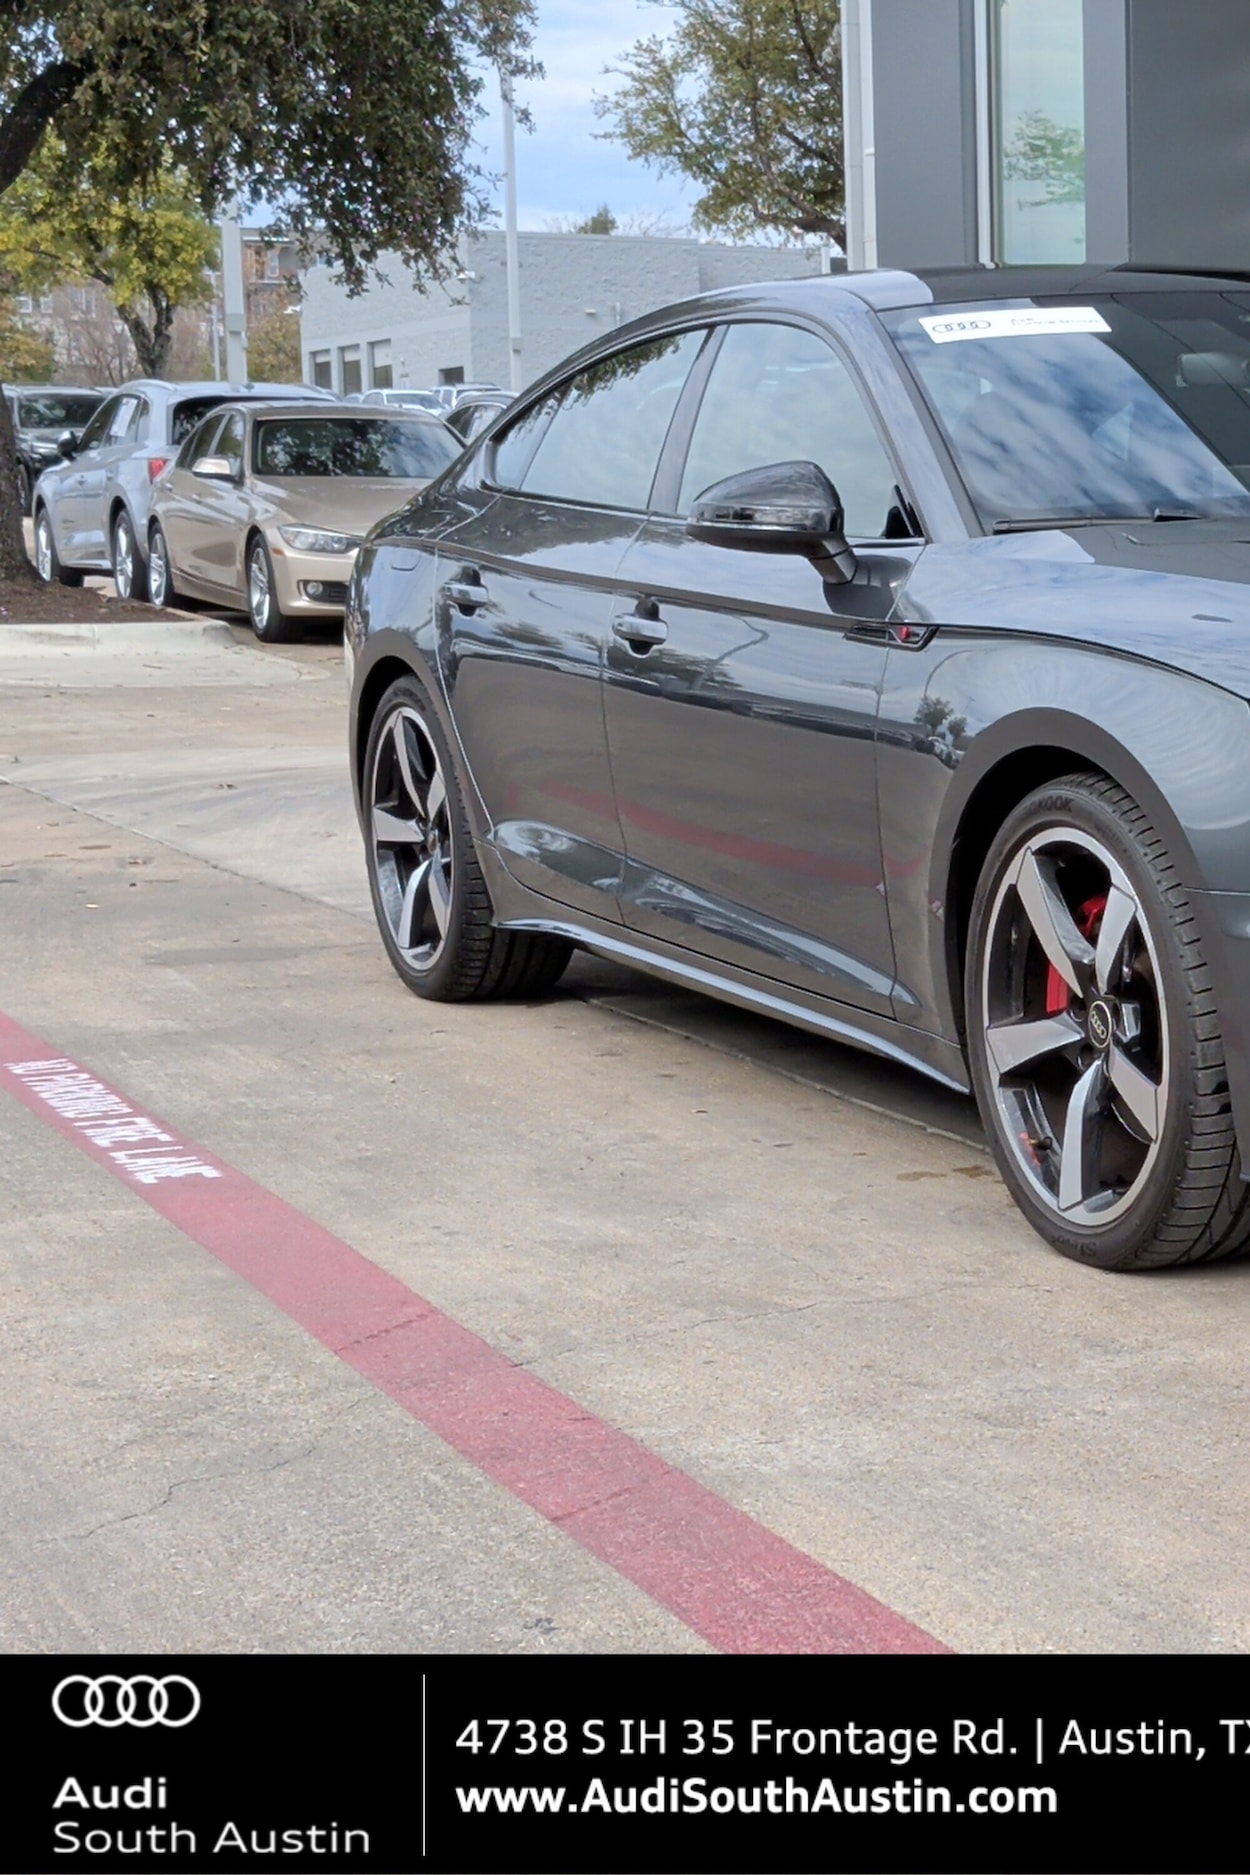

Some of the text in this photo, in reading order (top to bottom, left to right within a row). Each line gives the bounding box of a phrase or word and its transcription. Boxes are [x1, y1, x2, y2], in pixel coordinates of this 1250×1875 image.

[3, 1058, 223, 1184] NO PARKING FIRE LANE
